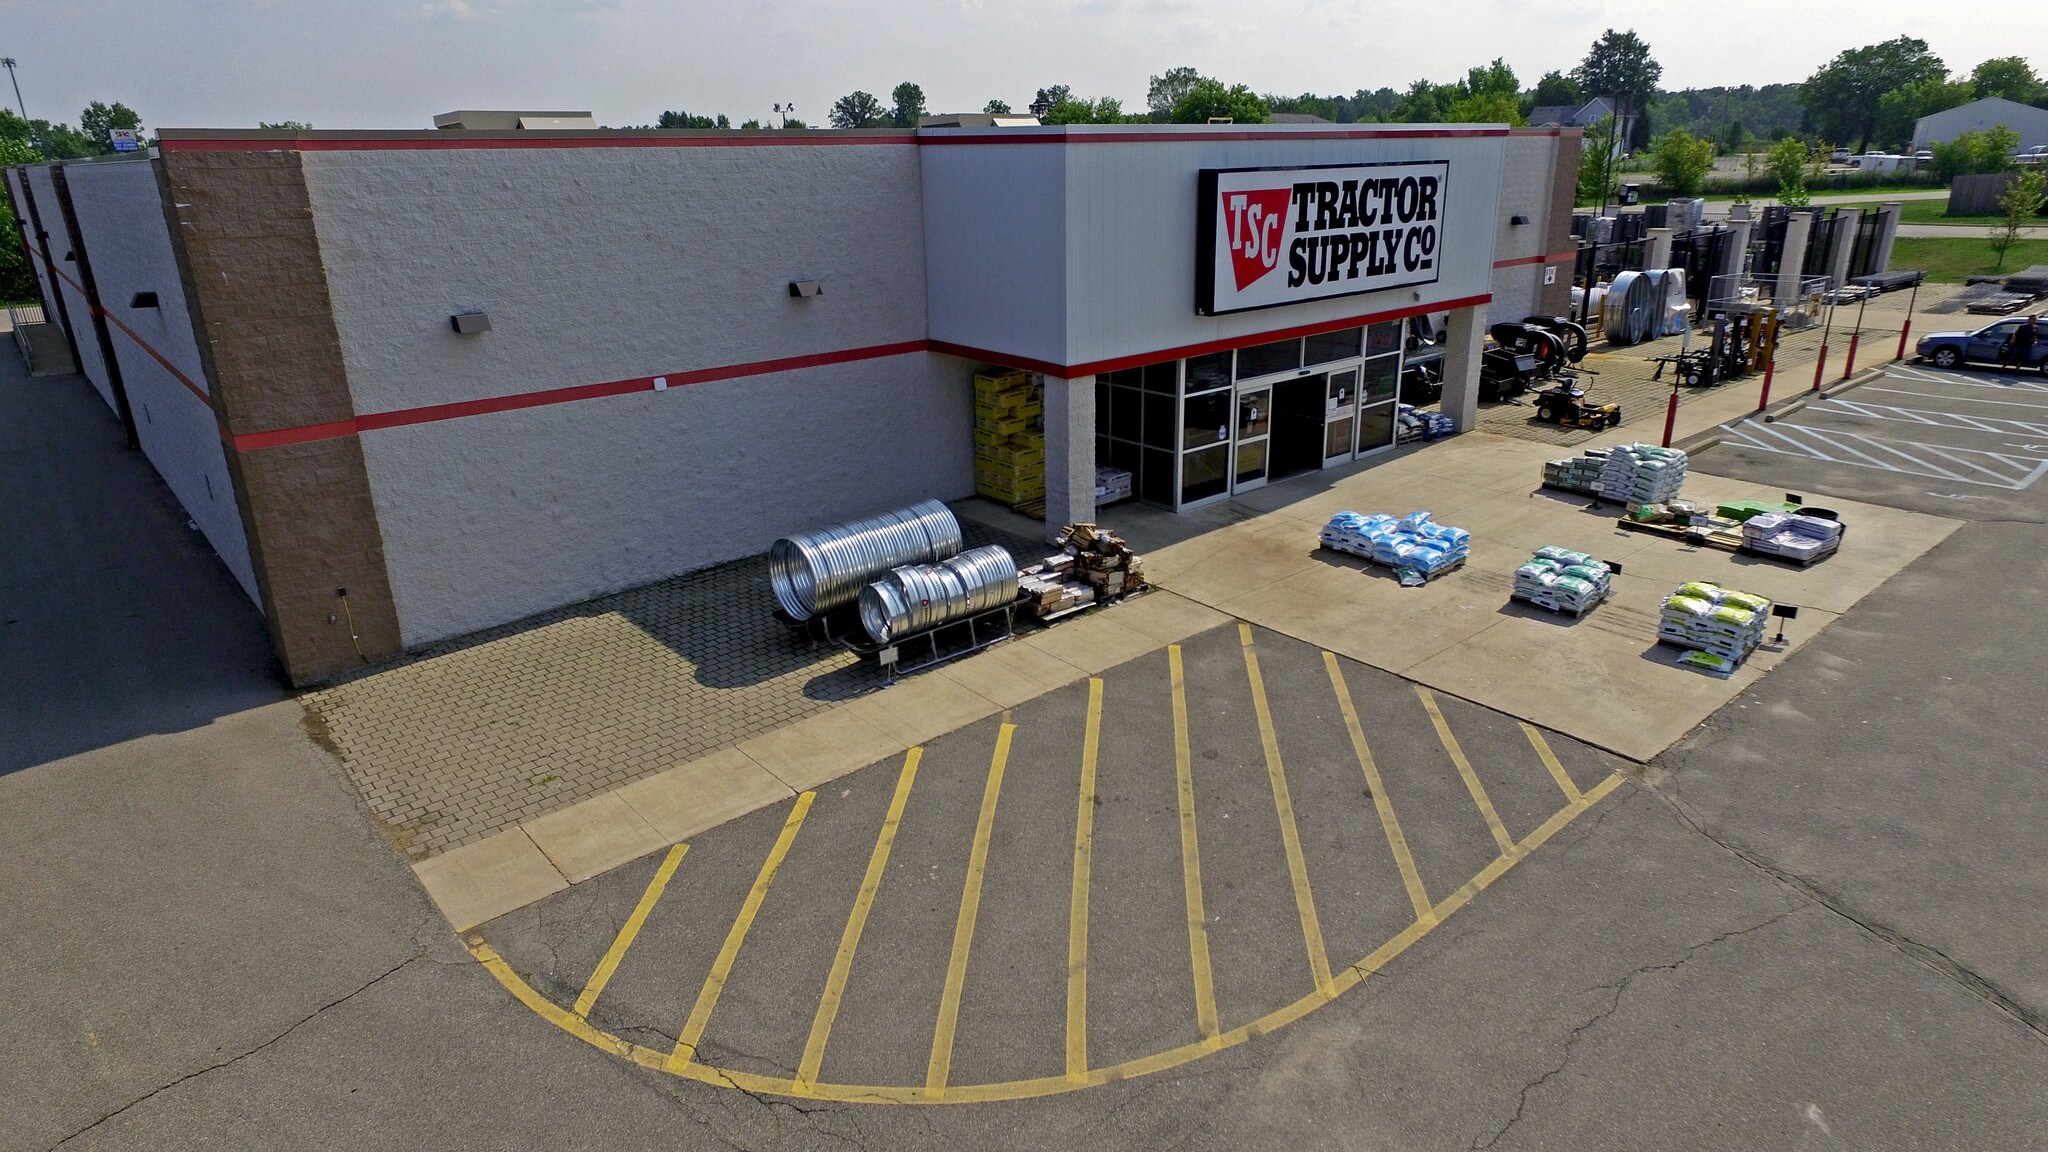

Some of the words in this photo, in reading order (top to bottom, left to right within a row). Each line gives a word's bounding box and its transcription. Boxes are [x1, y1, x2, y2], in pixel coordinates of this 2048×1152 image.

[1230, 194, 1279, 268] TSC
[1292, 175, 1438, 233] TRACTOR
[1288, 228, 1403, 288] SUPPLY
